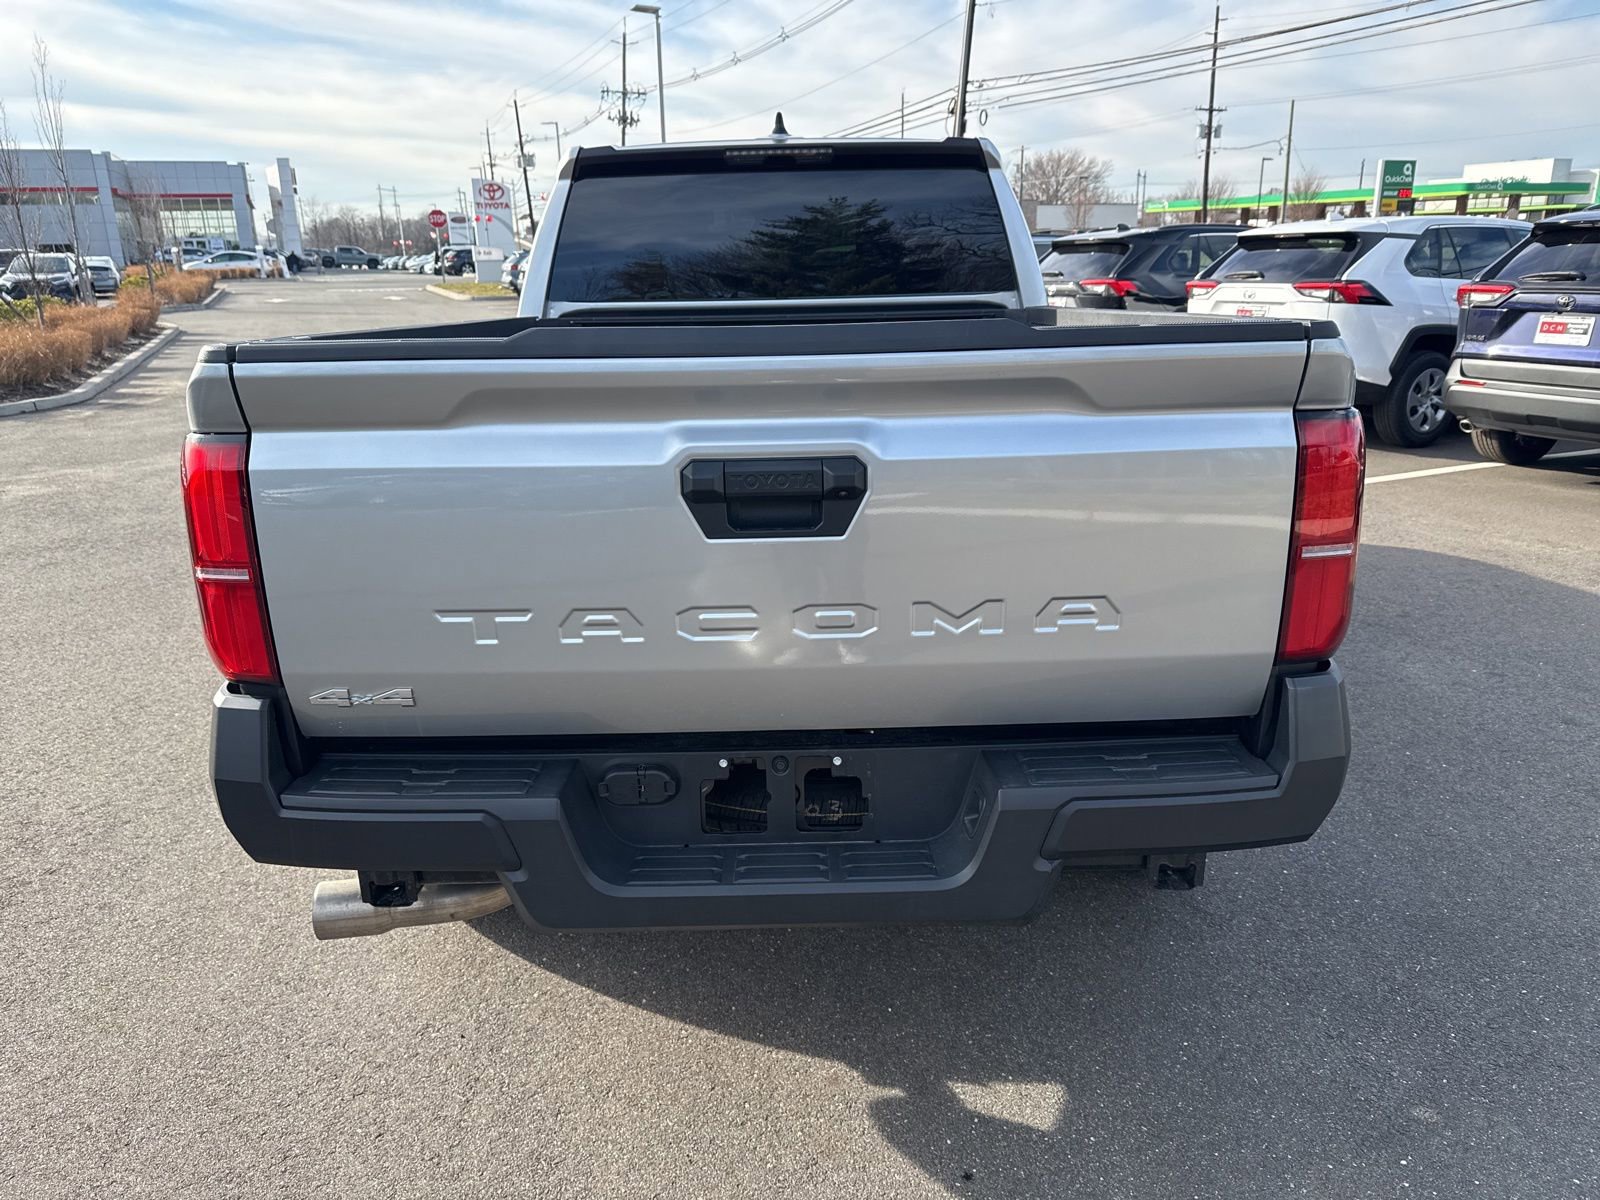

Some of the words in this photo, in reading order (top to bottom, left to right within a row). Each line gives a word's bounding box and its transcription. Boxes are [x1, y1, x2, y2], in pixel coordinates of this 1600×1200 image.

[429, 214, 446, 223] STOP
[728, 473, 820, 490] TOYOTA
[433, 595, 1121, 645] TACOMA
